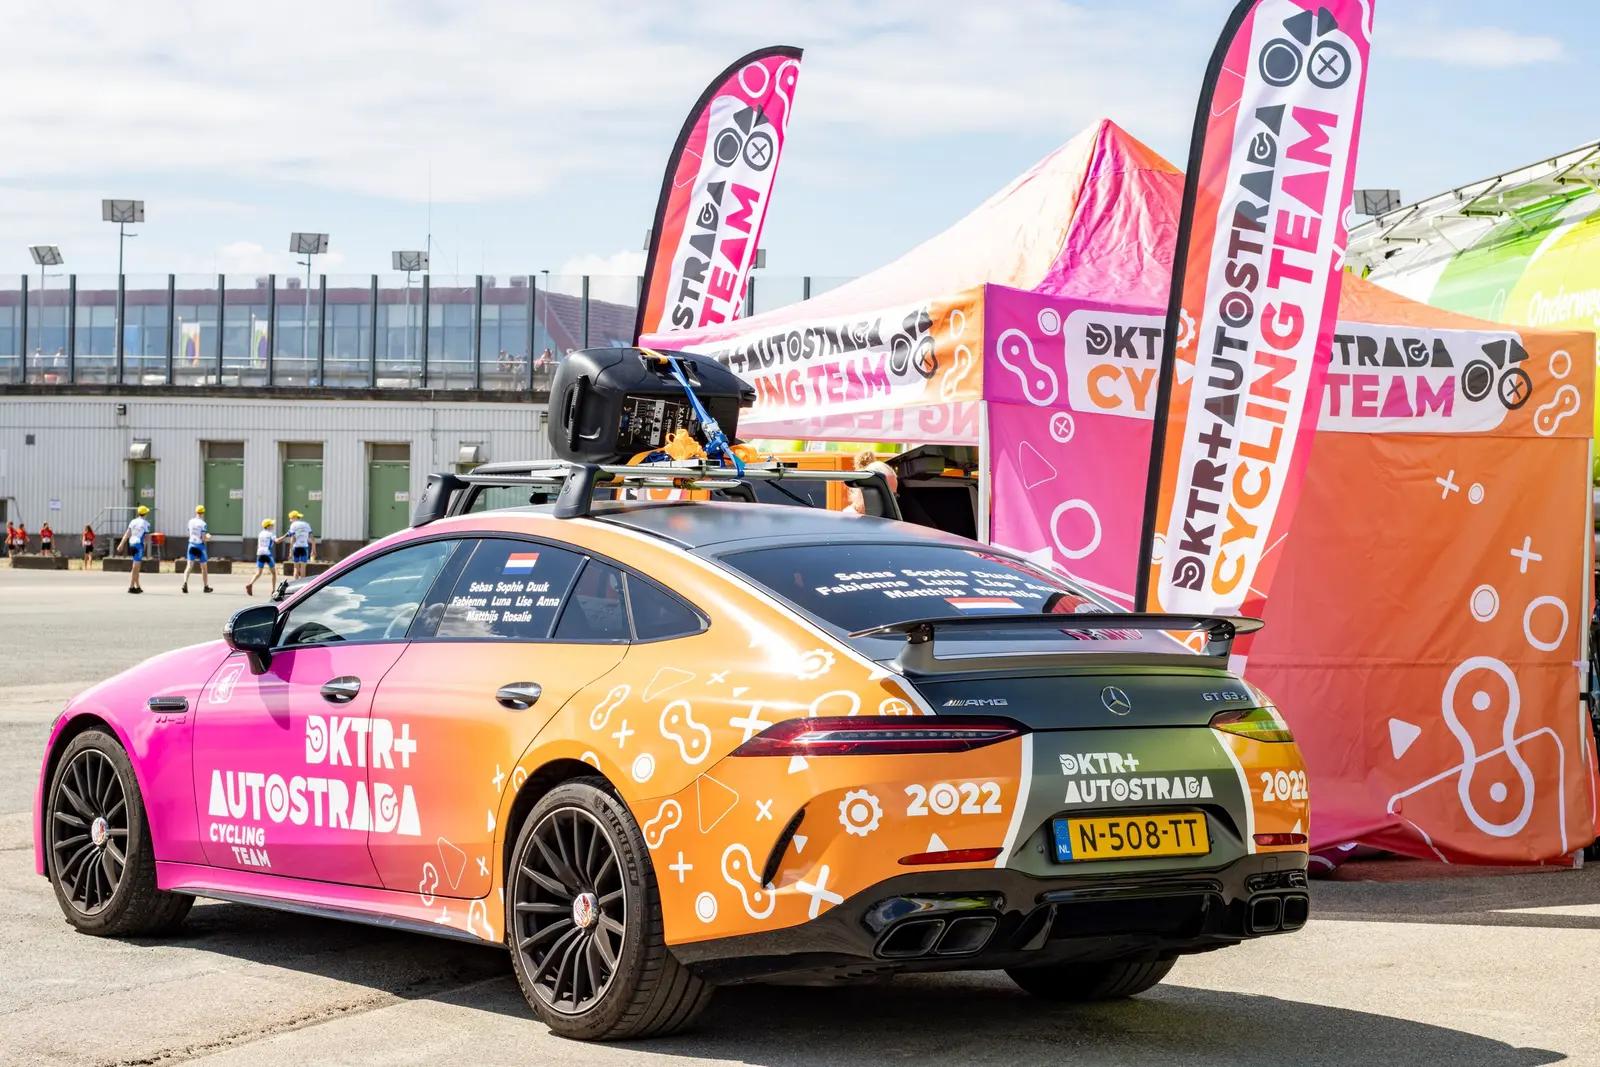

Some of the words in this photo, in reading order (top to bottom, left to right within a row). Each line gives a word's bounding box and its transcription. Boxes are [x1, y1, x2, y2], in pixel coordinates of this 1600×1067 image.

[670, 181, 726, 331] STRADA
[698, 183, 760, 328] TEAM
[1086, 322, 1165, 361] DKT
[1330, 334, 1454, 368] TRADA
[1211, 301, 1305, 595] CYCLING
[1266, 106, 1338, 289] TEAM
[754, 369, 805, 408] ING
[807, 353, 891, 407] TEAM
[1087, 363, 1157, 411] CY
[1321, 374, 1455, 417] TEAM
[469, 581, 494, 592] Sebas
[496, 580, 524, 594] Sophie
[526, 581, 550, 592] Duuk
[815, 580, 909, 596] Fabienne
[917, 578, 969, 586] Luna
[834, 571, 896, 581] Sebas
[901, 569, 968, 577] Sophie
[451, 596, 487, 607] Fabienne
[491, 596, 511, 606] Luna
[515, 596, 533, 607] Lise
[536, 596, 560, 606] Anna
[883, 587, 967, 598] Matthijs
[466, 611, 498, 623] Matthijs
[502, 611, 532, 622] Rosalie
[964, 698, 1008, 706] AMG
[1202, 692, 1219, 701] GT
[305, 715, 417, 769] DKTR+
[1059, 752, 1140, 776] DKTR+
[903, 781, 1002, 817] 2022
[1064, 775, 1214, 804] AUTOSTRADA
[1260, 769, 1309, 802] 2022
[208, 769, 422, 836] AUTOSTRADA
[209, 822, 265, 848] CYCLING
[604, 808, 639, 882] MICHELIN
[1058, 844, 1070, 853] NL
[1079, 819, 1197, 853] N-508-TT
[231, 846, 271, 868] TEAM
